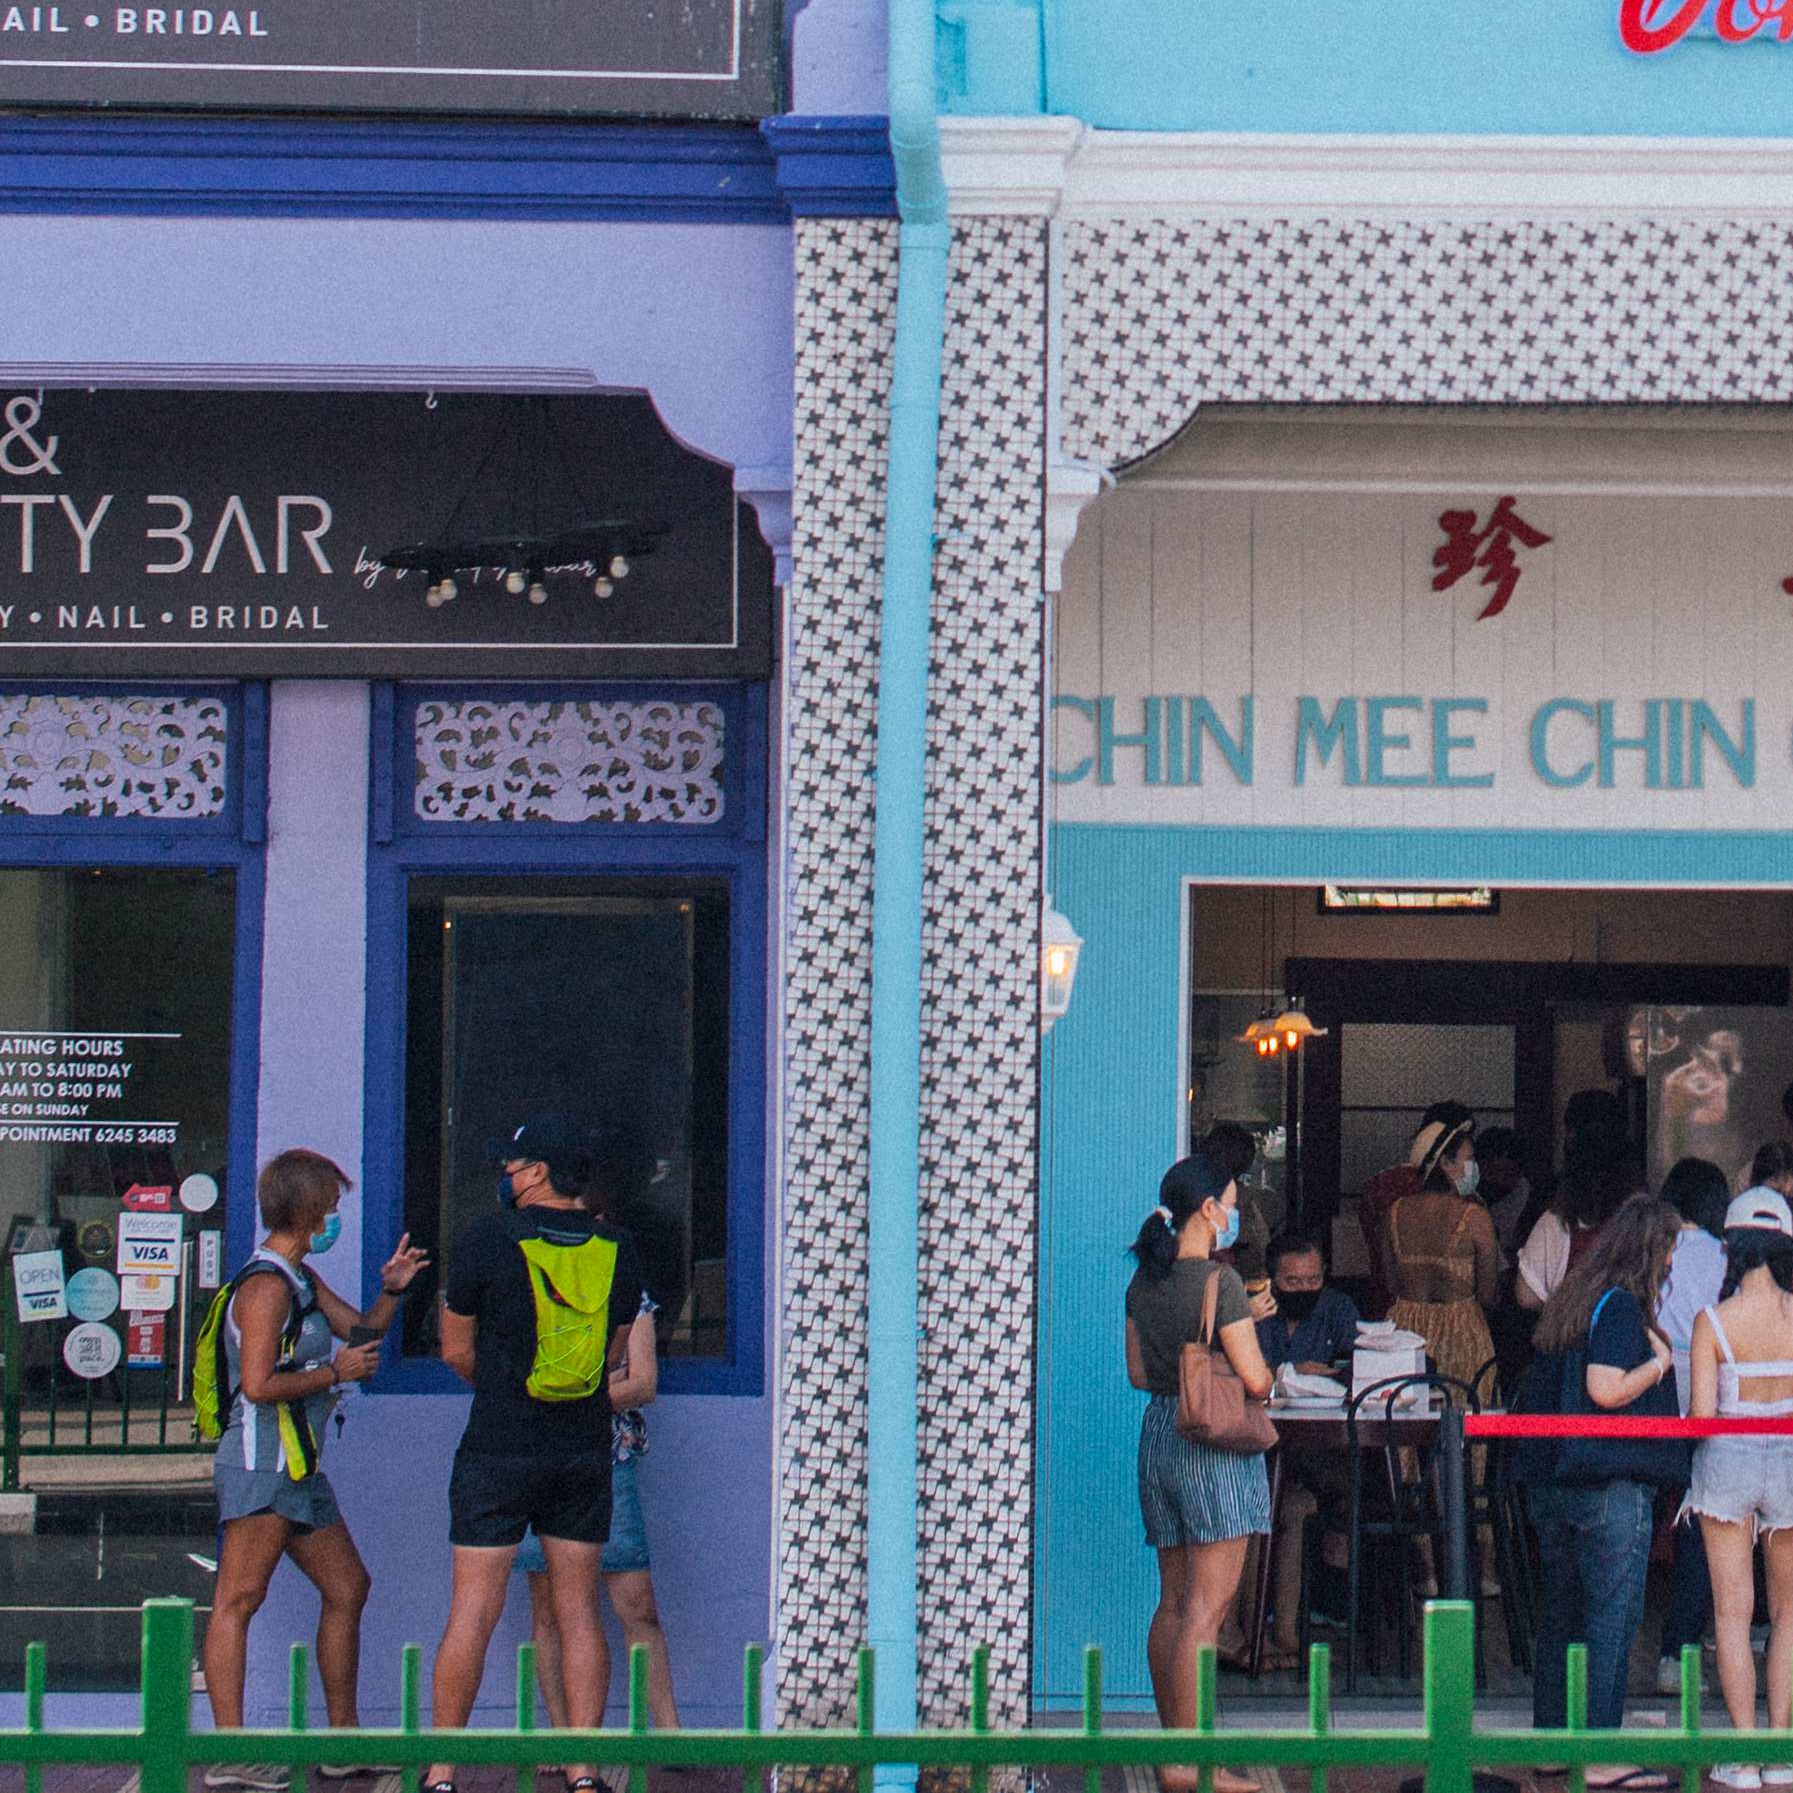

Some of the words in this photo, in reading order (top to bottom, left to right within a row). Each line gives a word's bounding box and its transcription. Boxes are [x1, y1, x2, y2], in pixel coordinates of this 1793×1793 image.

[116, 8, 269, 36] BRIDAL
[0, 395, 62, 476] &
[0, 494, 114, 574] TY
[146, 494, 334, 574] BAR
[354, 545, 387, 590] by
[59, 606, 146, 629] NAIL
[190, 606, 329, 630] BRIDAL
[1050, 694, 1254, 787] CHIN
[1293, 696, 1494, 788] MEE
[1528, 696, 1756, 790] CHIN
[61, 1039, 124, 1057] HOURS
[20, 1062, 43, 1078] TO
[46, 1062, 133, 1080] SATURDAY
[31, 1083, 54, 1098] TO
[57, 1083, 93, 1099] 8:00
[96, 1084, 123, 1100] PM
[11, 1104, 33, 1117] ON
[35, 1105, 90, 1118] SUNDAY
[95, 1128, 135, 1144] 6245
[138, 1129, 177, 1145] 3483
[131, 1246, 169, 1261] VISA
[20, 1268, 60, 1285] OPEN
[30, 1297, 58, 1310] VISA
